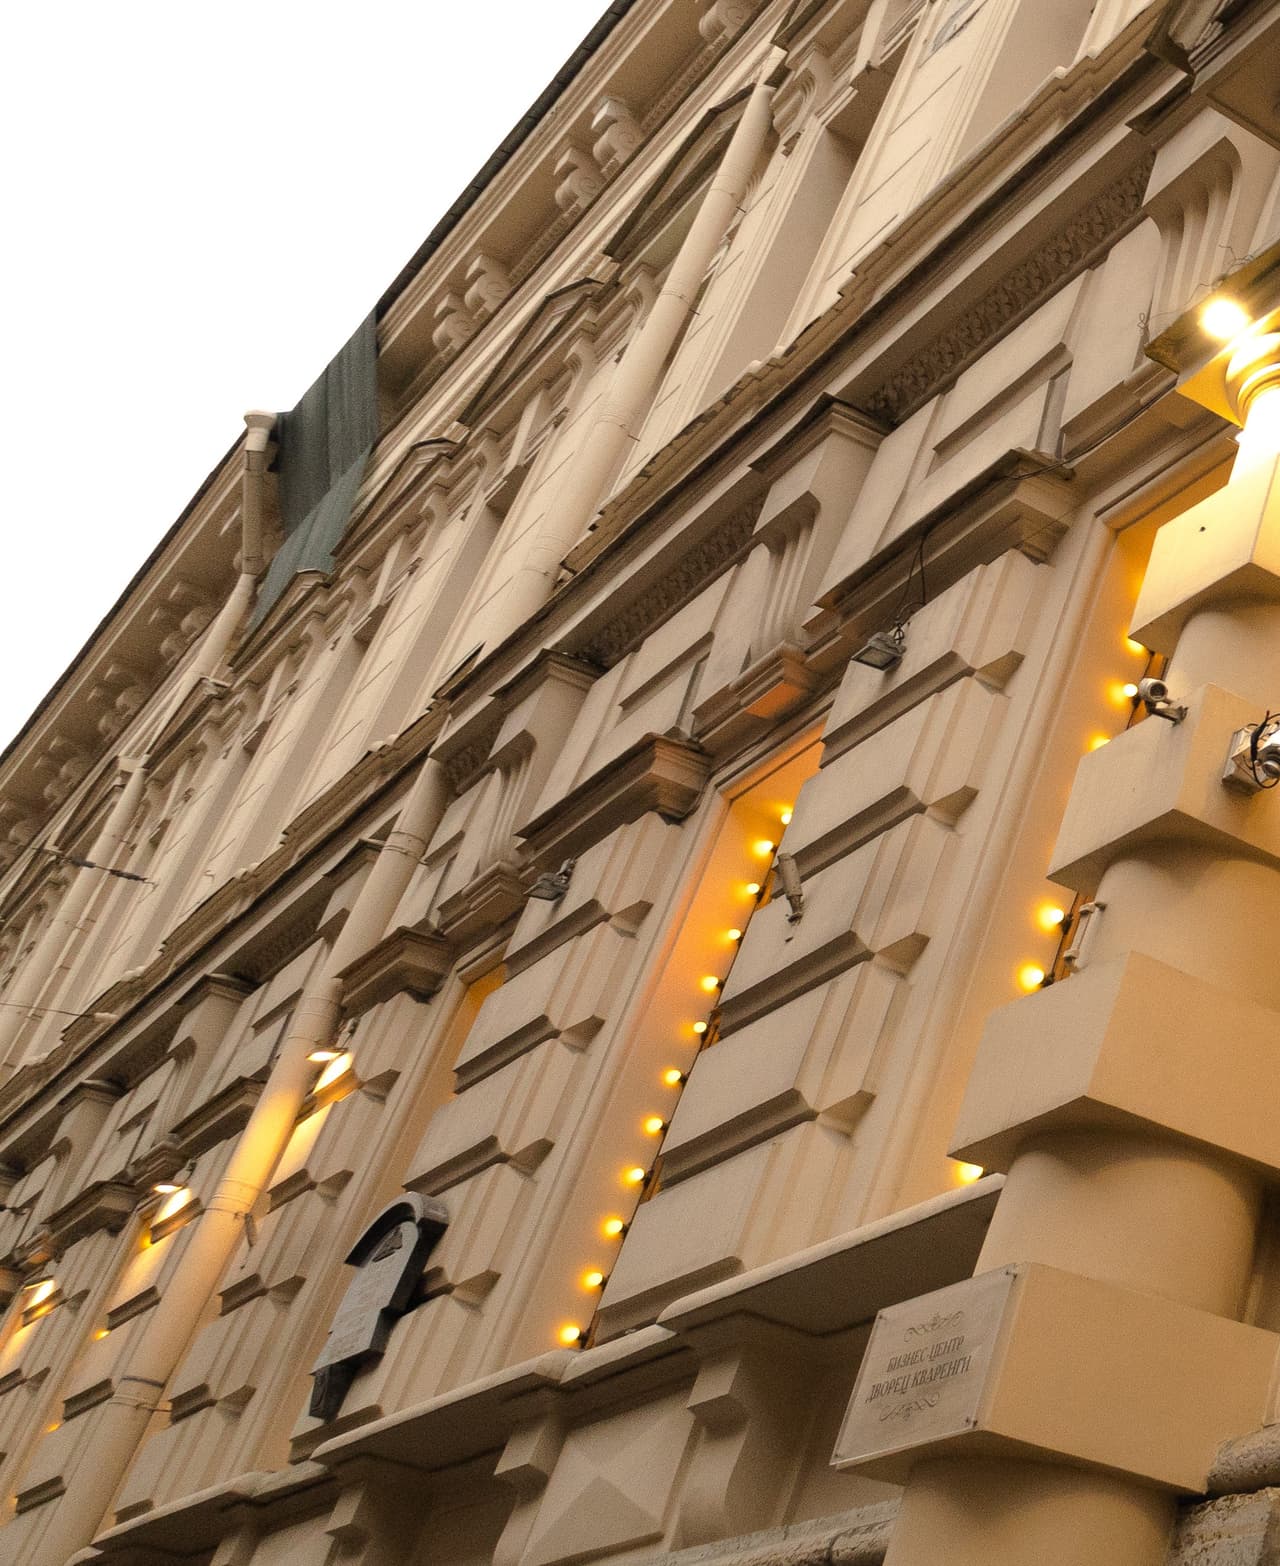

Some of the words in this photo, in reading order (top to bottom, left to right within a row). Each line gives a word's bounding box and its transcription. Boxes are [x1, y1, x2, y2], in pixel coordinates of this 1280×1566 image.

[886, 1336, 965, 1373] БИЗНЕС-ЦЕНТР
[865, 1373, 911, 1404] ДВОРЕЦ
[911, 1355, 972, 1388] КВАРЕНГИ
